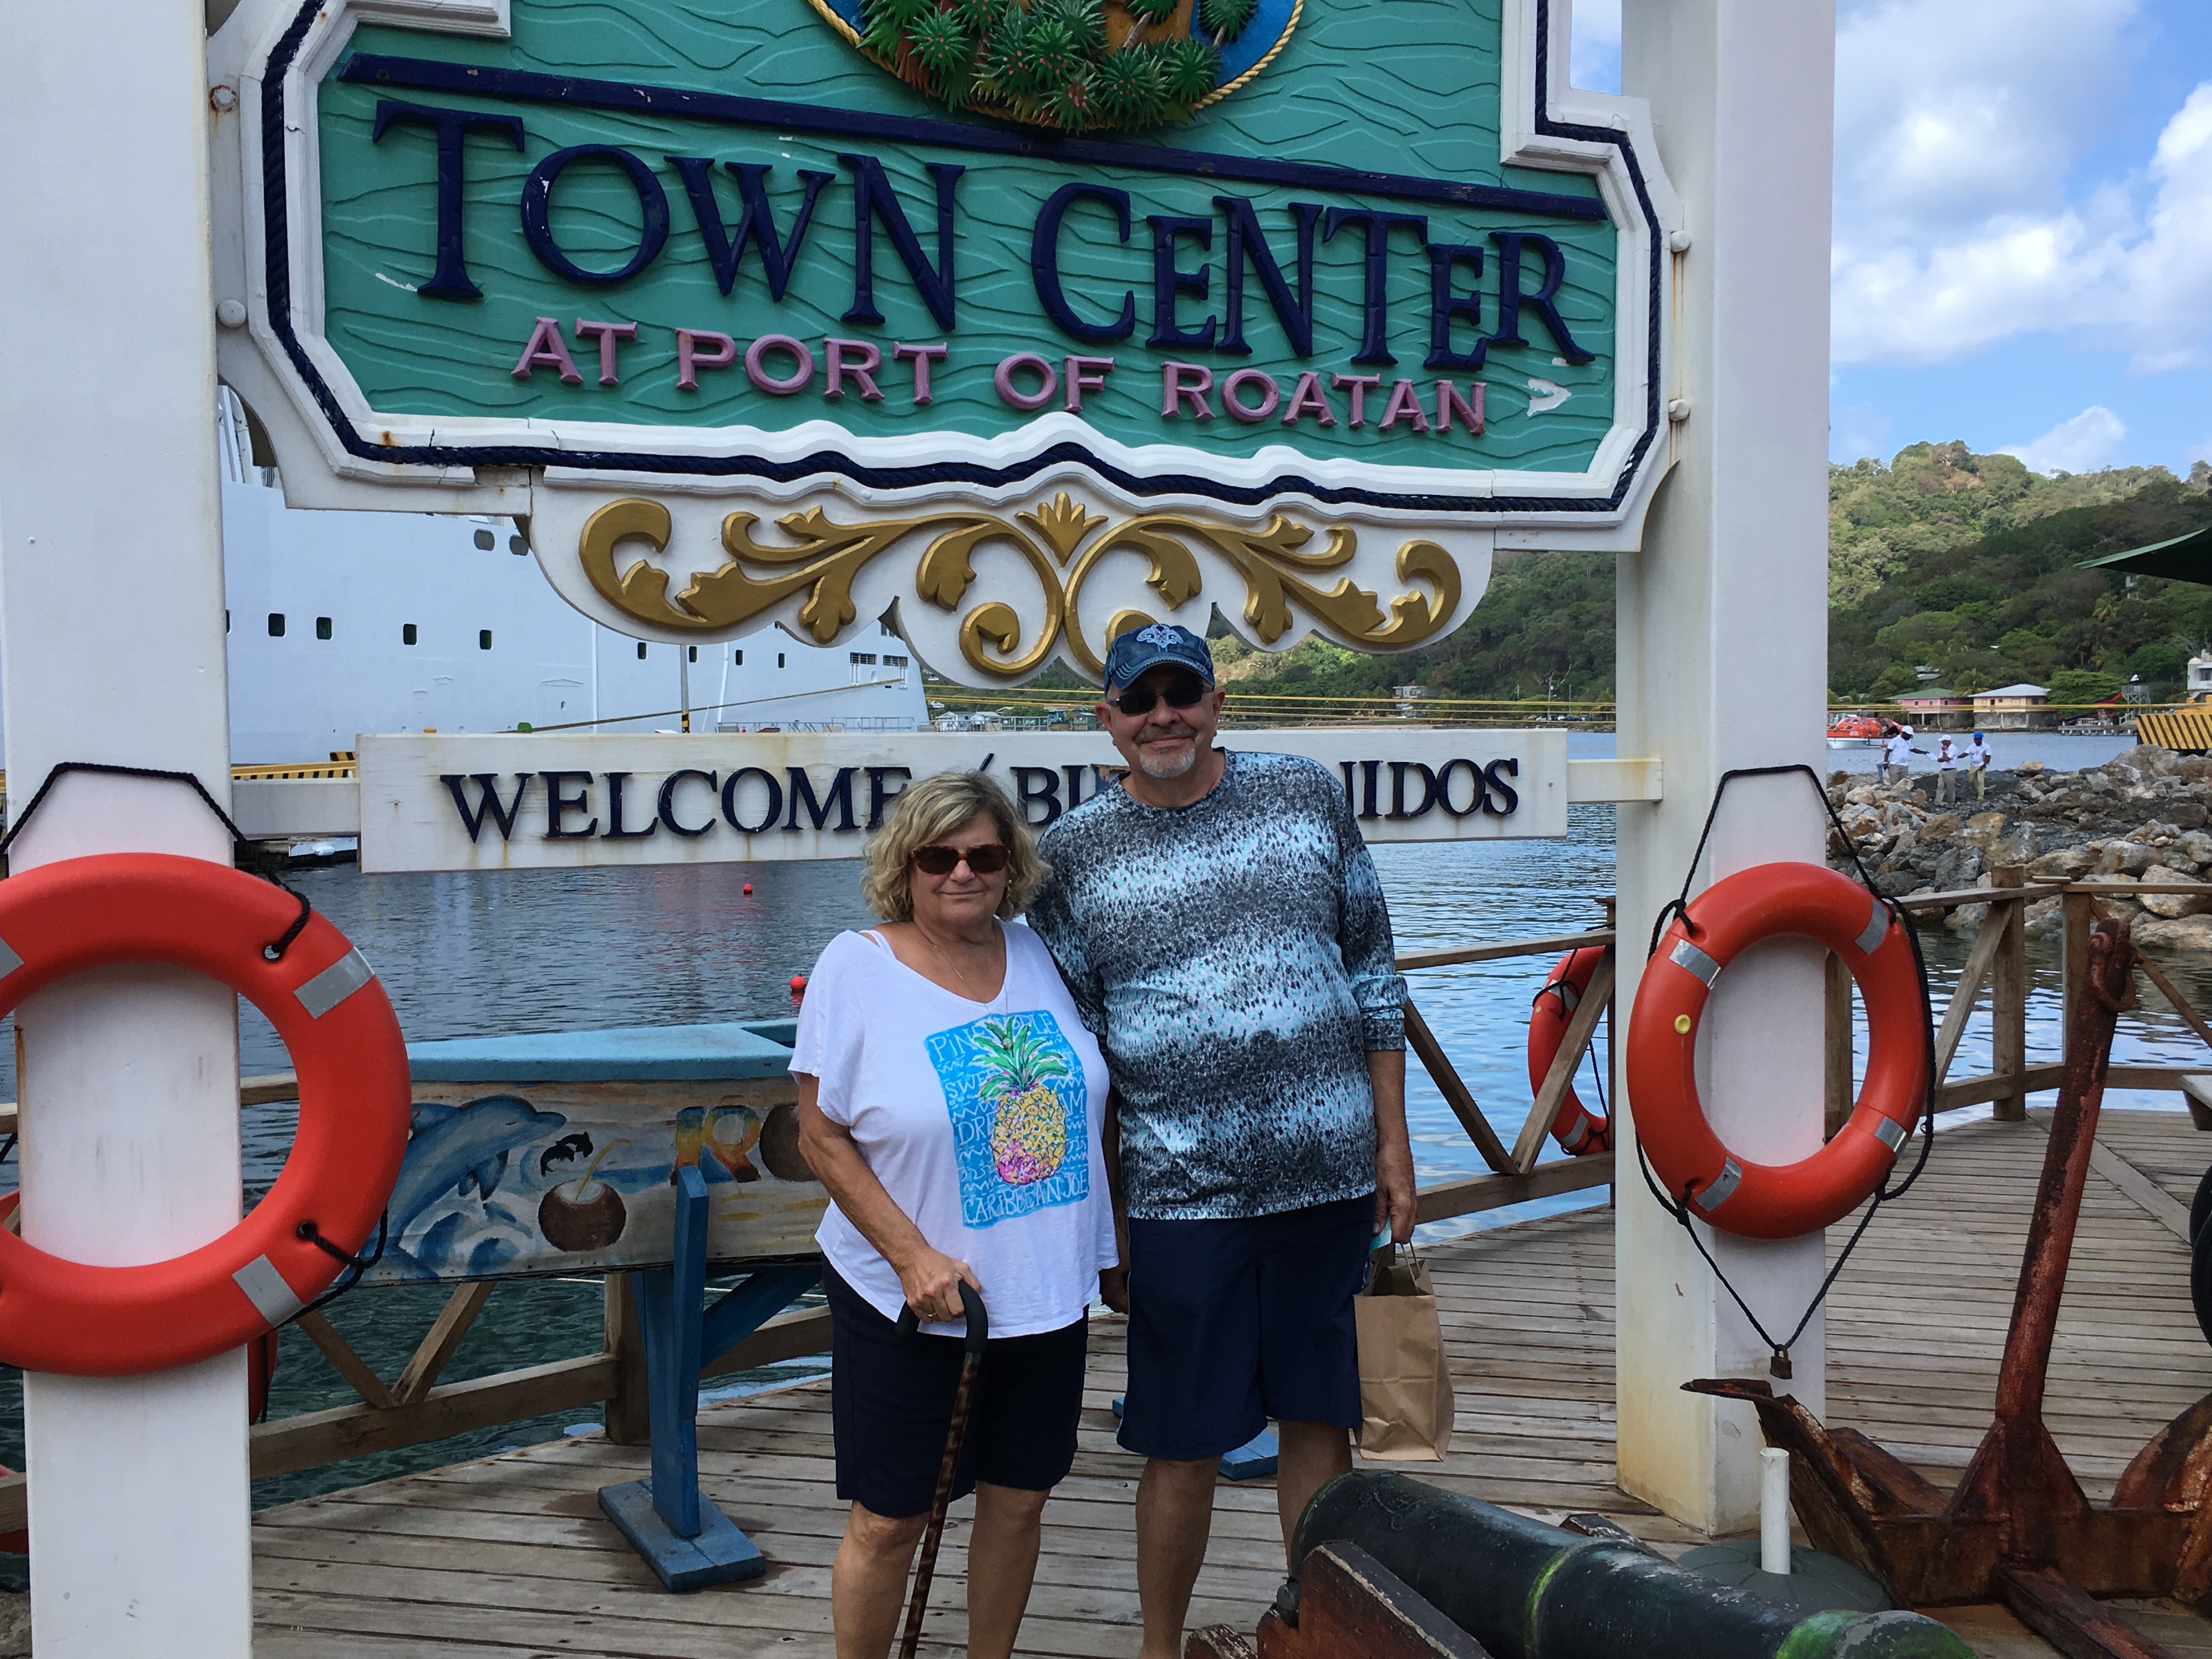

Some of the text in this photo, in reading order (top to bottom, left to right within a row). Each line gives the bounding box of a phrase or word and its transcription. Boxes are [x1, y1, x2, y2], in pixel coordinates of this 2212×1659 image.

[372, 99, 1596, 371] TOWN CENTER
[511, 317, 1488, 436] AT PORT OF ROATAN
[440, 766, 912, 844] WELCOME
